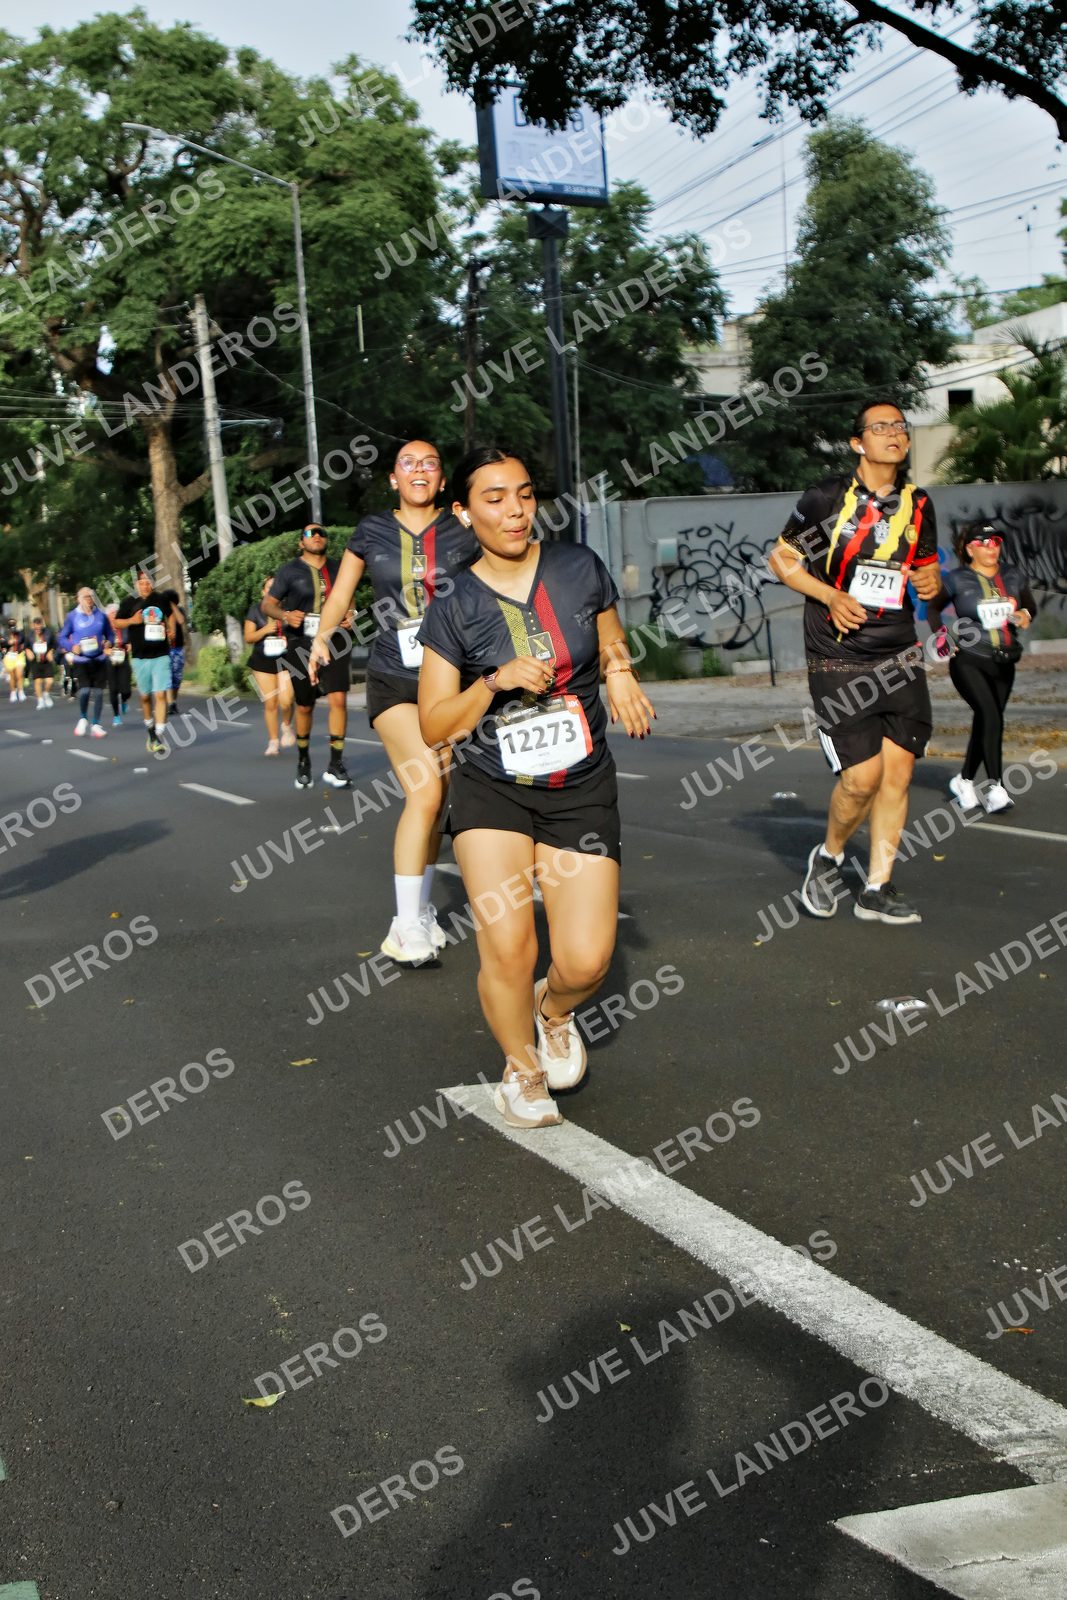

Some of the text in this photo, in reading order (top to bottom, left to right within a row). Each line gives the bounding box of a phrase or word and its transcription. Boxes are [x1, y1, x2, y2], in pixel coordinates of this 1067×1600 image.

[676, 521, 735, 543] TOY
[860, 571, 895, 591] 9721
[503, 719, 577, 754] 12273
